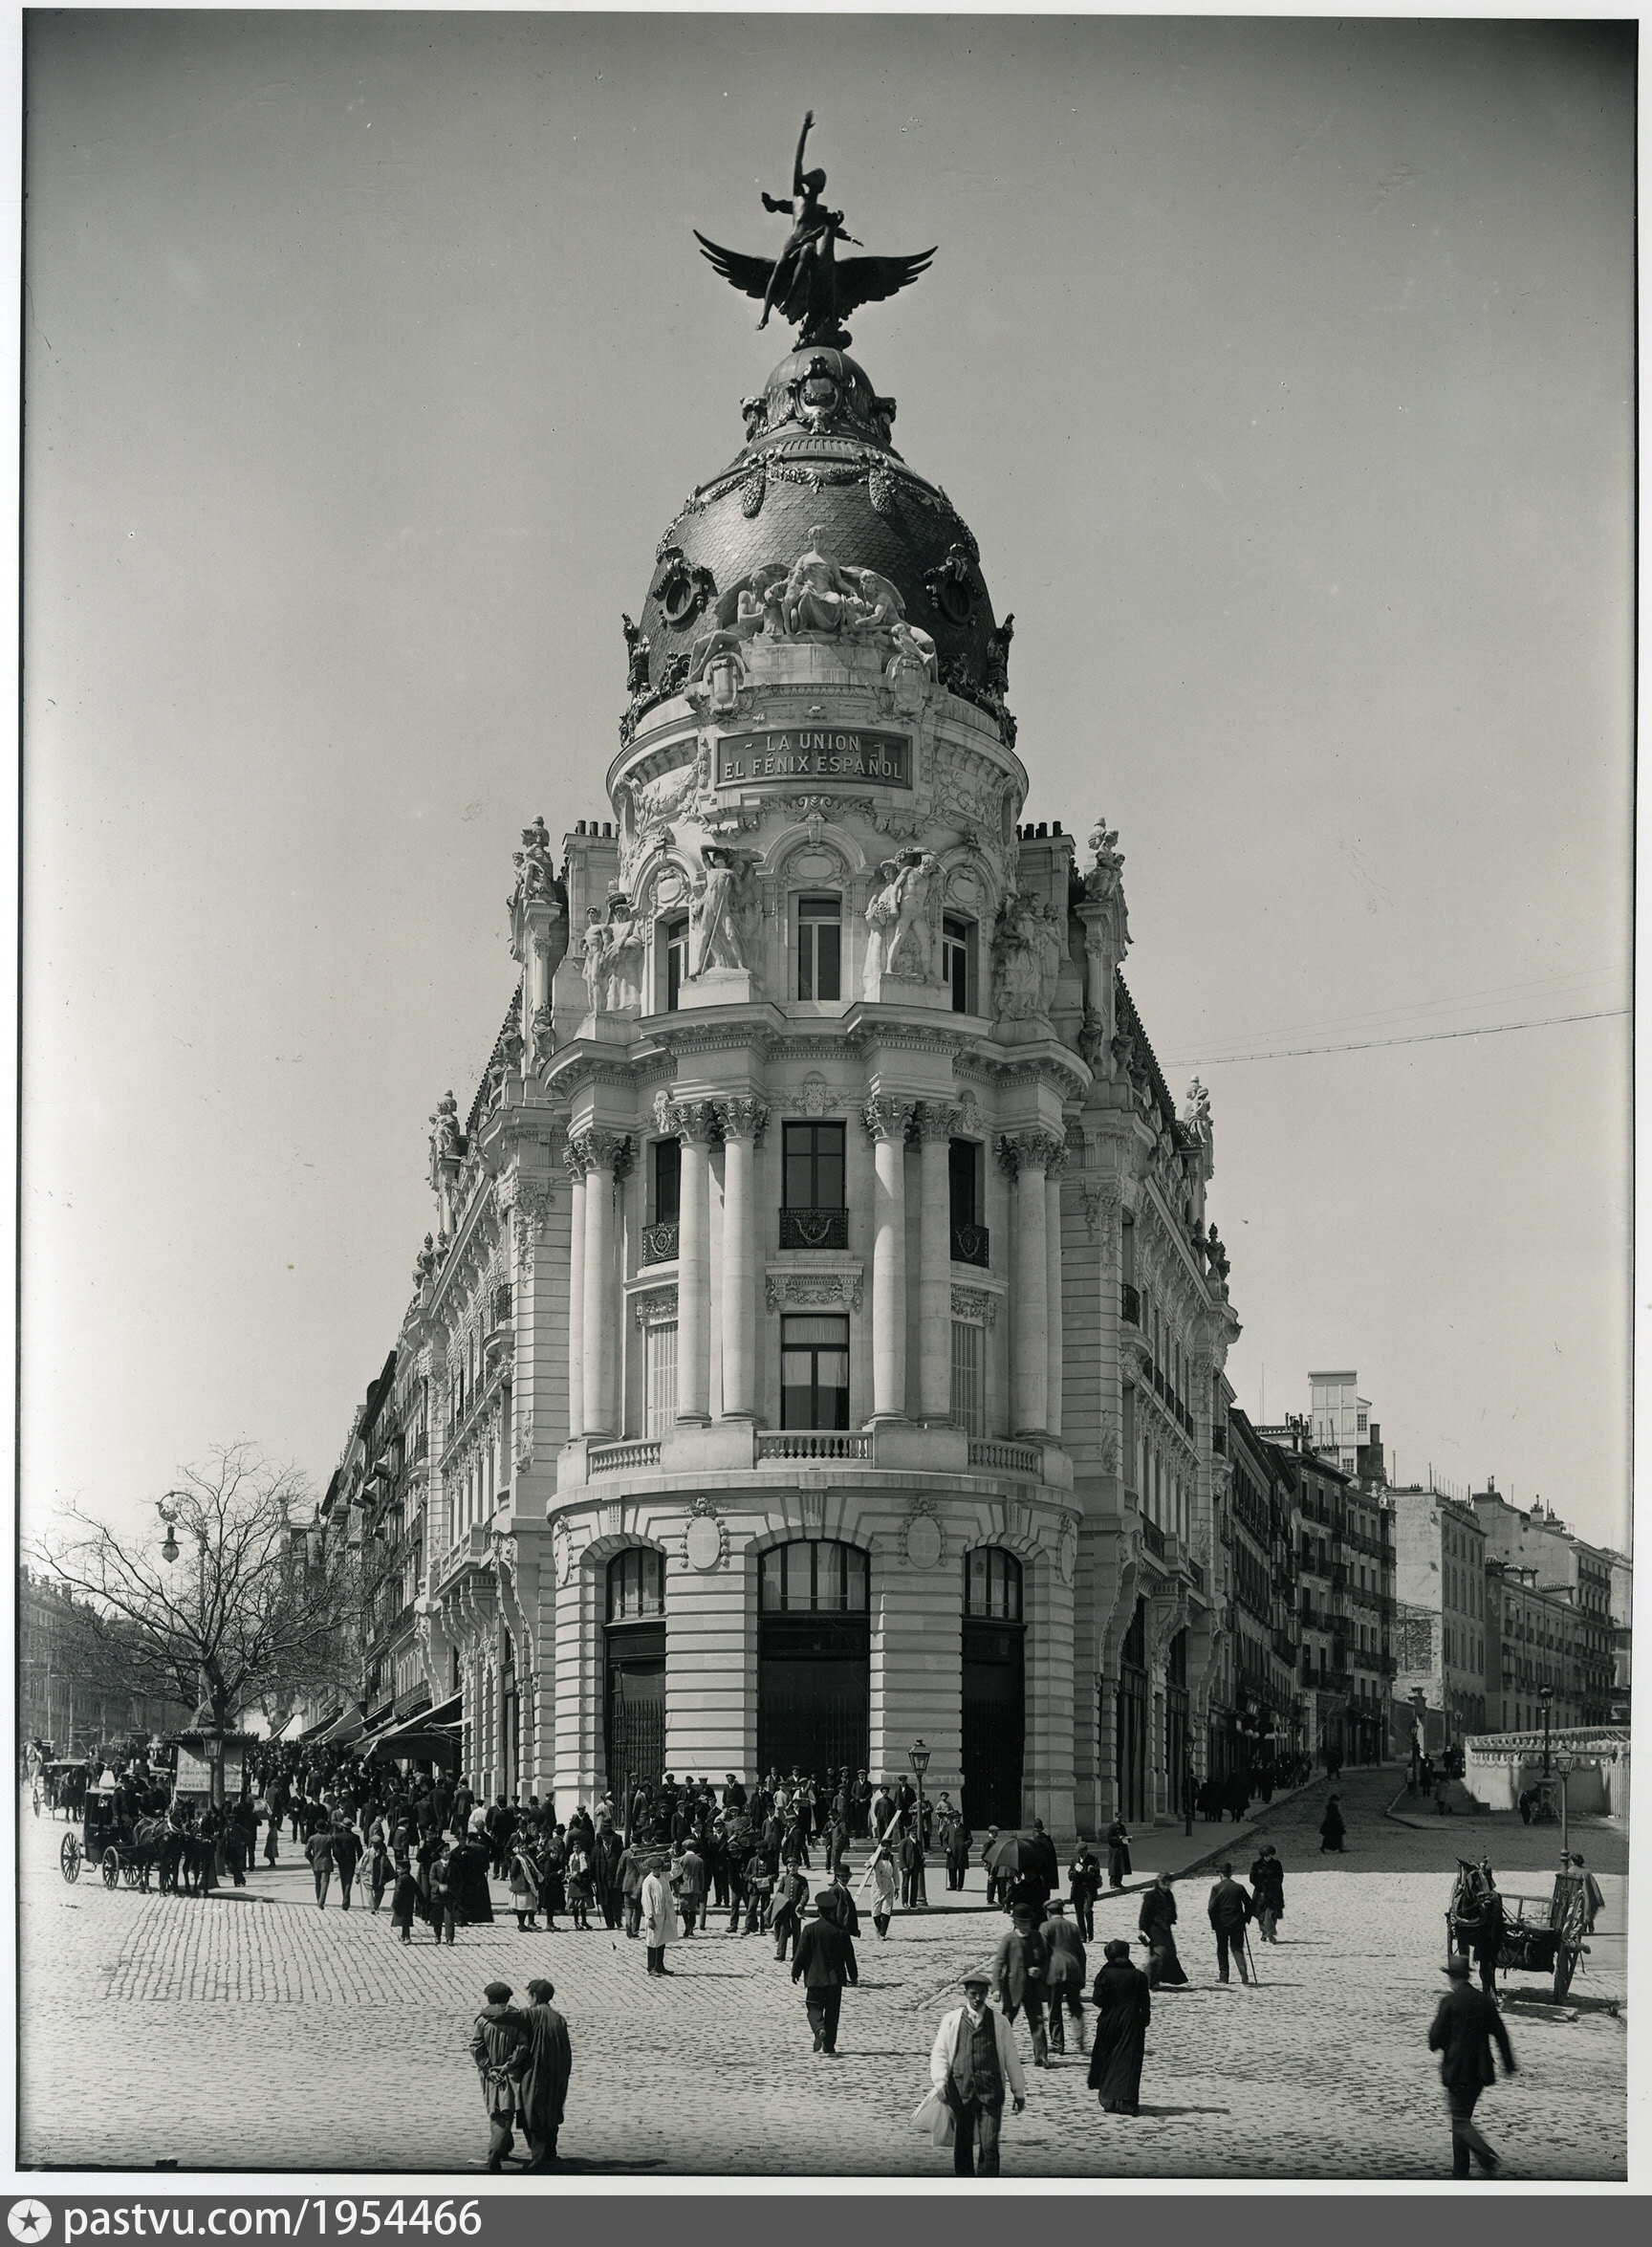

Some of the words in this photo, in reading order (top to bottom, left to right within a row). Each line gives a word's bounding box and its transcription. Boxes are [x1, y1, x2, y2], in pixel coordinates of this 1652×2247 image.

[766, 735, 792, 752] LA
[799, 733, 859, 752] UNION
[724, 762, 745, 779] EL
[752, 753, 809, 775] FÉNIX
[816, 753, 902, 779] ESPAÑOL
